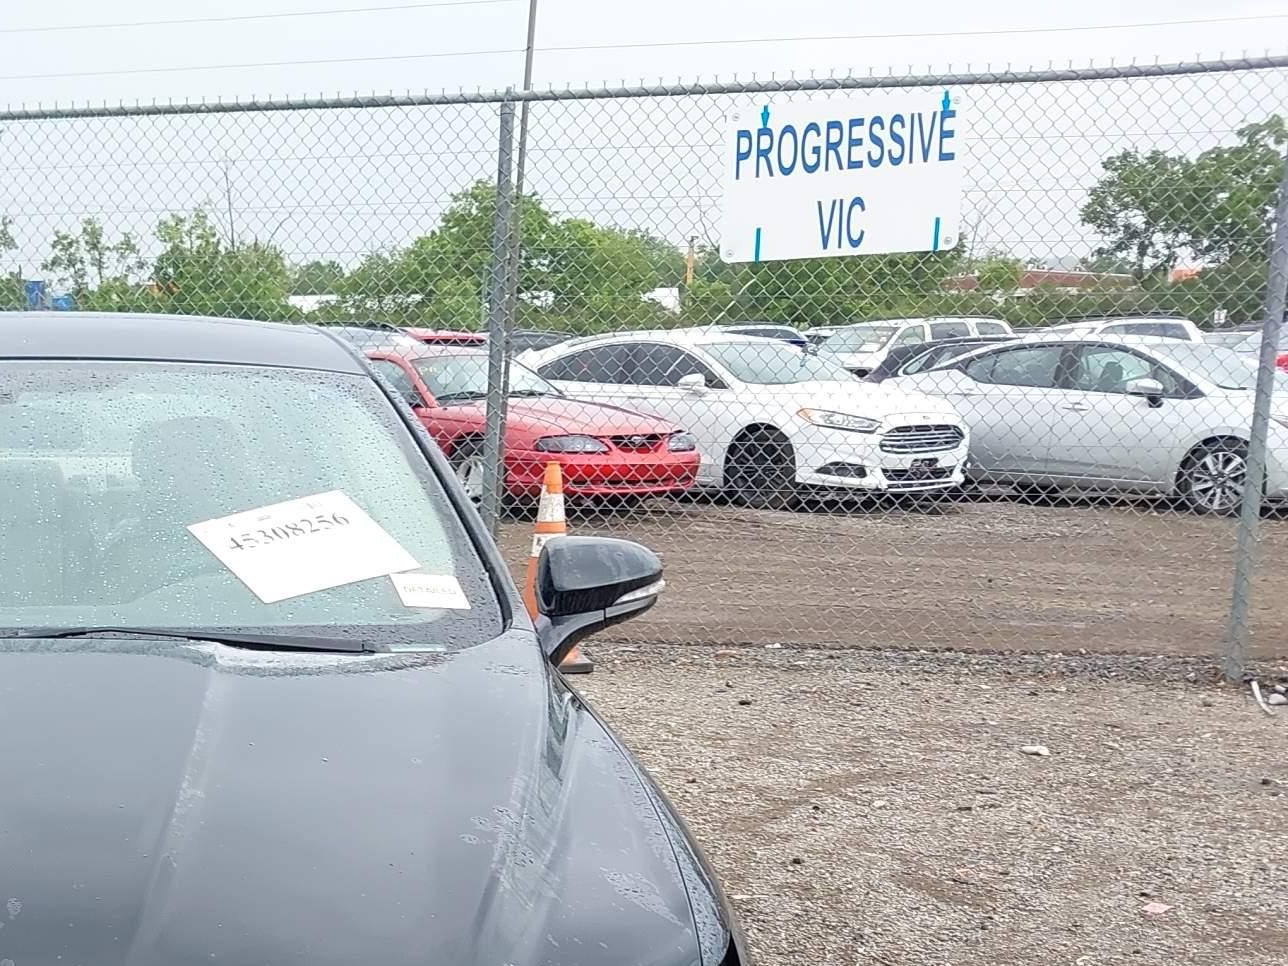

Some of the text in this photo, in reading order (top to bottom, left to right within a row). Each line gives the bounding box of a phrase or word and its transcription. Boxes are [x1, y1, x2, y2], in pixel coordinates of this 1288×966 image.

[735, 109, 957, 181] PROGRESSIVE
[817, 196, 866, 250] VIC
[228, 511, 351, 552] 45308256
